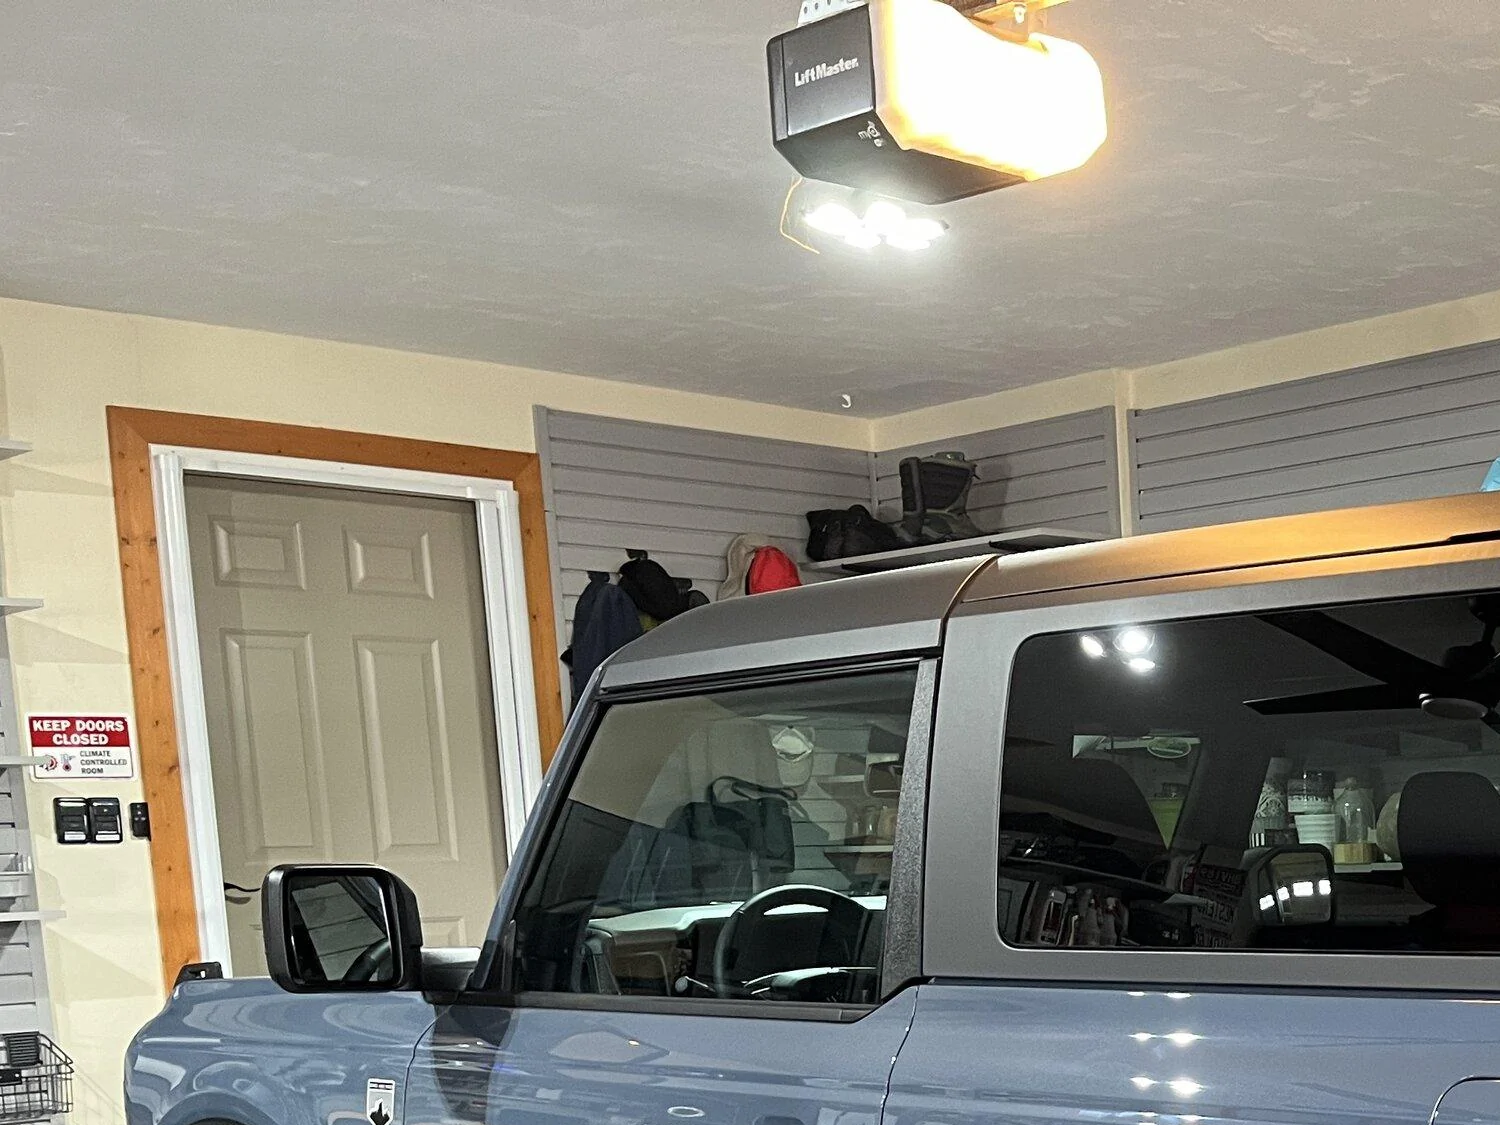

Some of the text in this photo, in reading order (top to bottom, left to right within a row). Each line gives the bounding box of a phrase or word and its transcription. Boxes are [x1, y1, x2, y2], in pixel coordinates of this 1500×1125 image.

[794, 56, 859, 87] LiftMaster
[32, 719, 125, 732] KEEP DOORS
[52, 733, 109, 745] CLOSED
